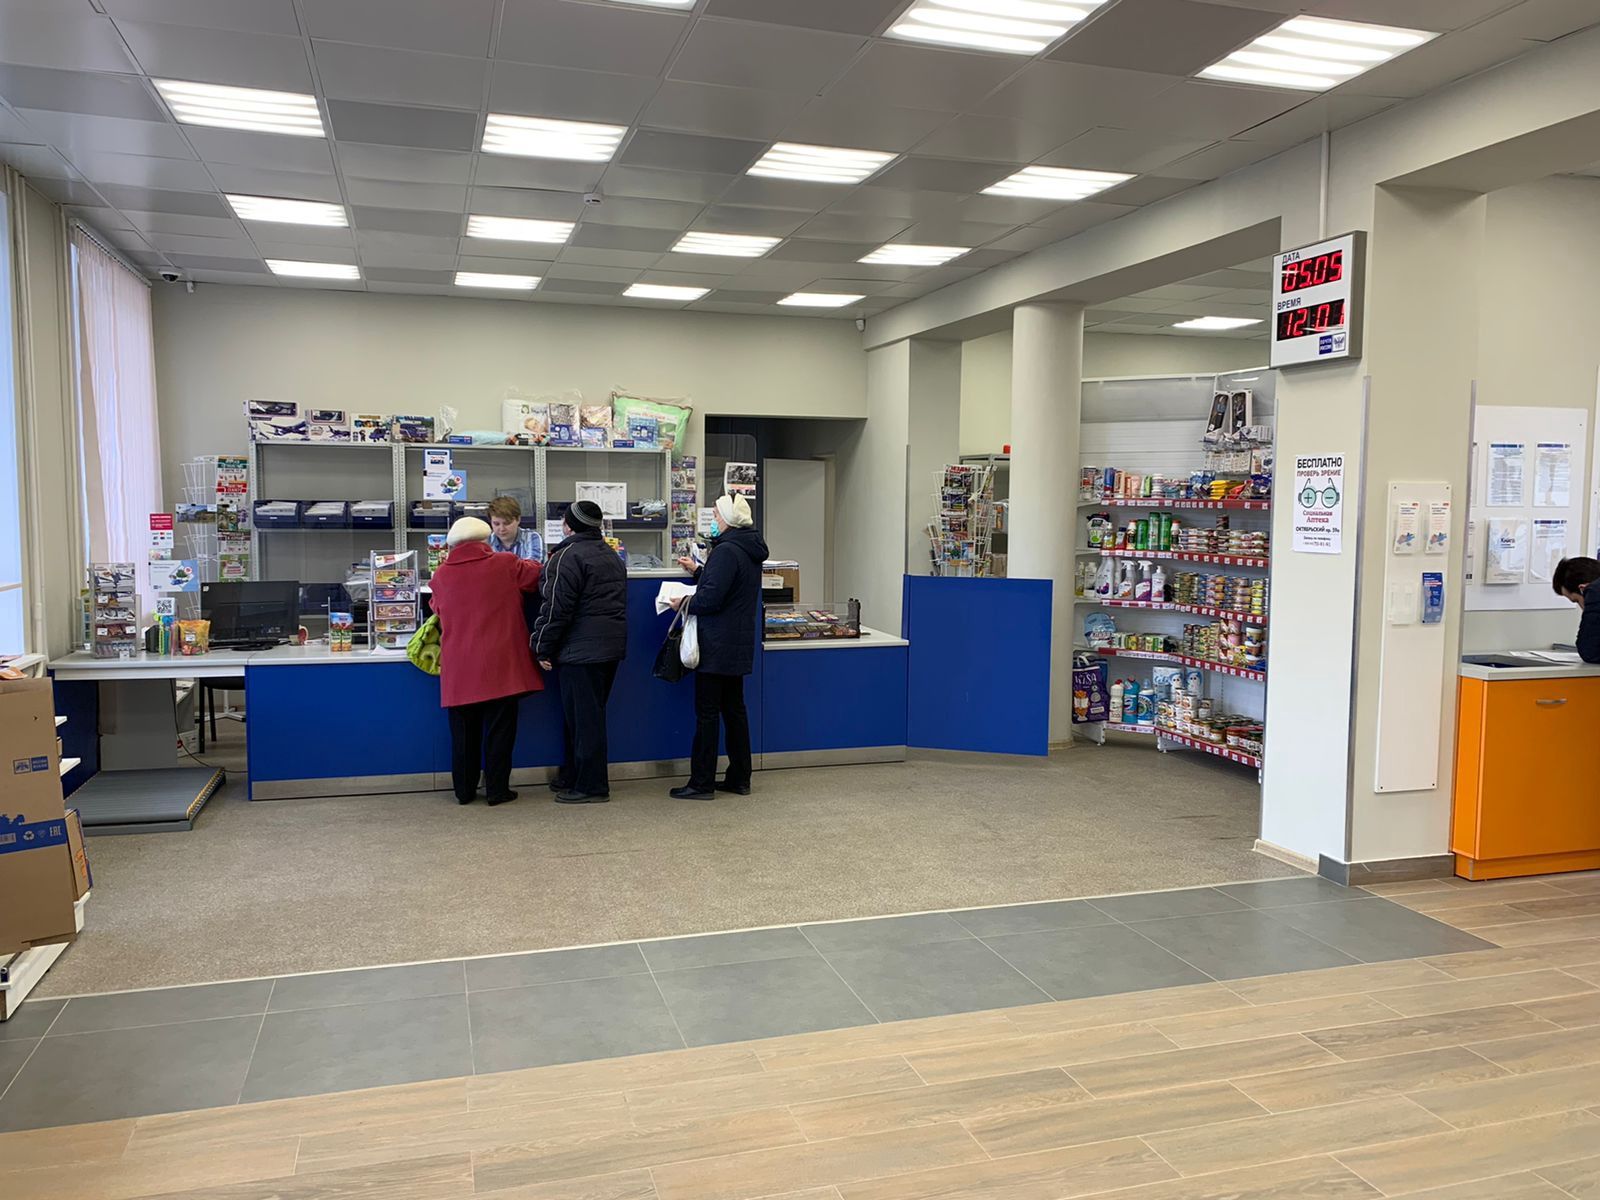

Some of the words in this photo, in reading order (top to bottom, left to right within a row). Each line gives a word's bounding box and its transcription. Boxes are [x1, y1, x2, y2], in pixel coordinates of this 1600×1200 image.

[1282, 251, 1301, 265] ДАТА
[1283, 253, 1343, 290] 05.05
[1277, 297, 1302, 311] ВРЕМЯ
[1297, 457, 1342, 469] БЕСПЛАТНО
